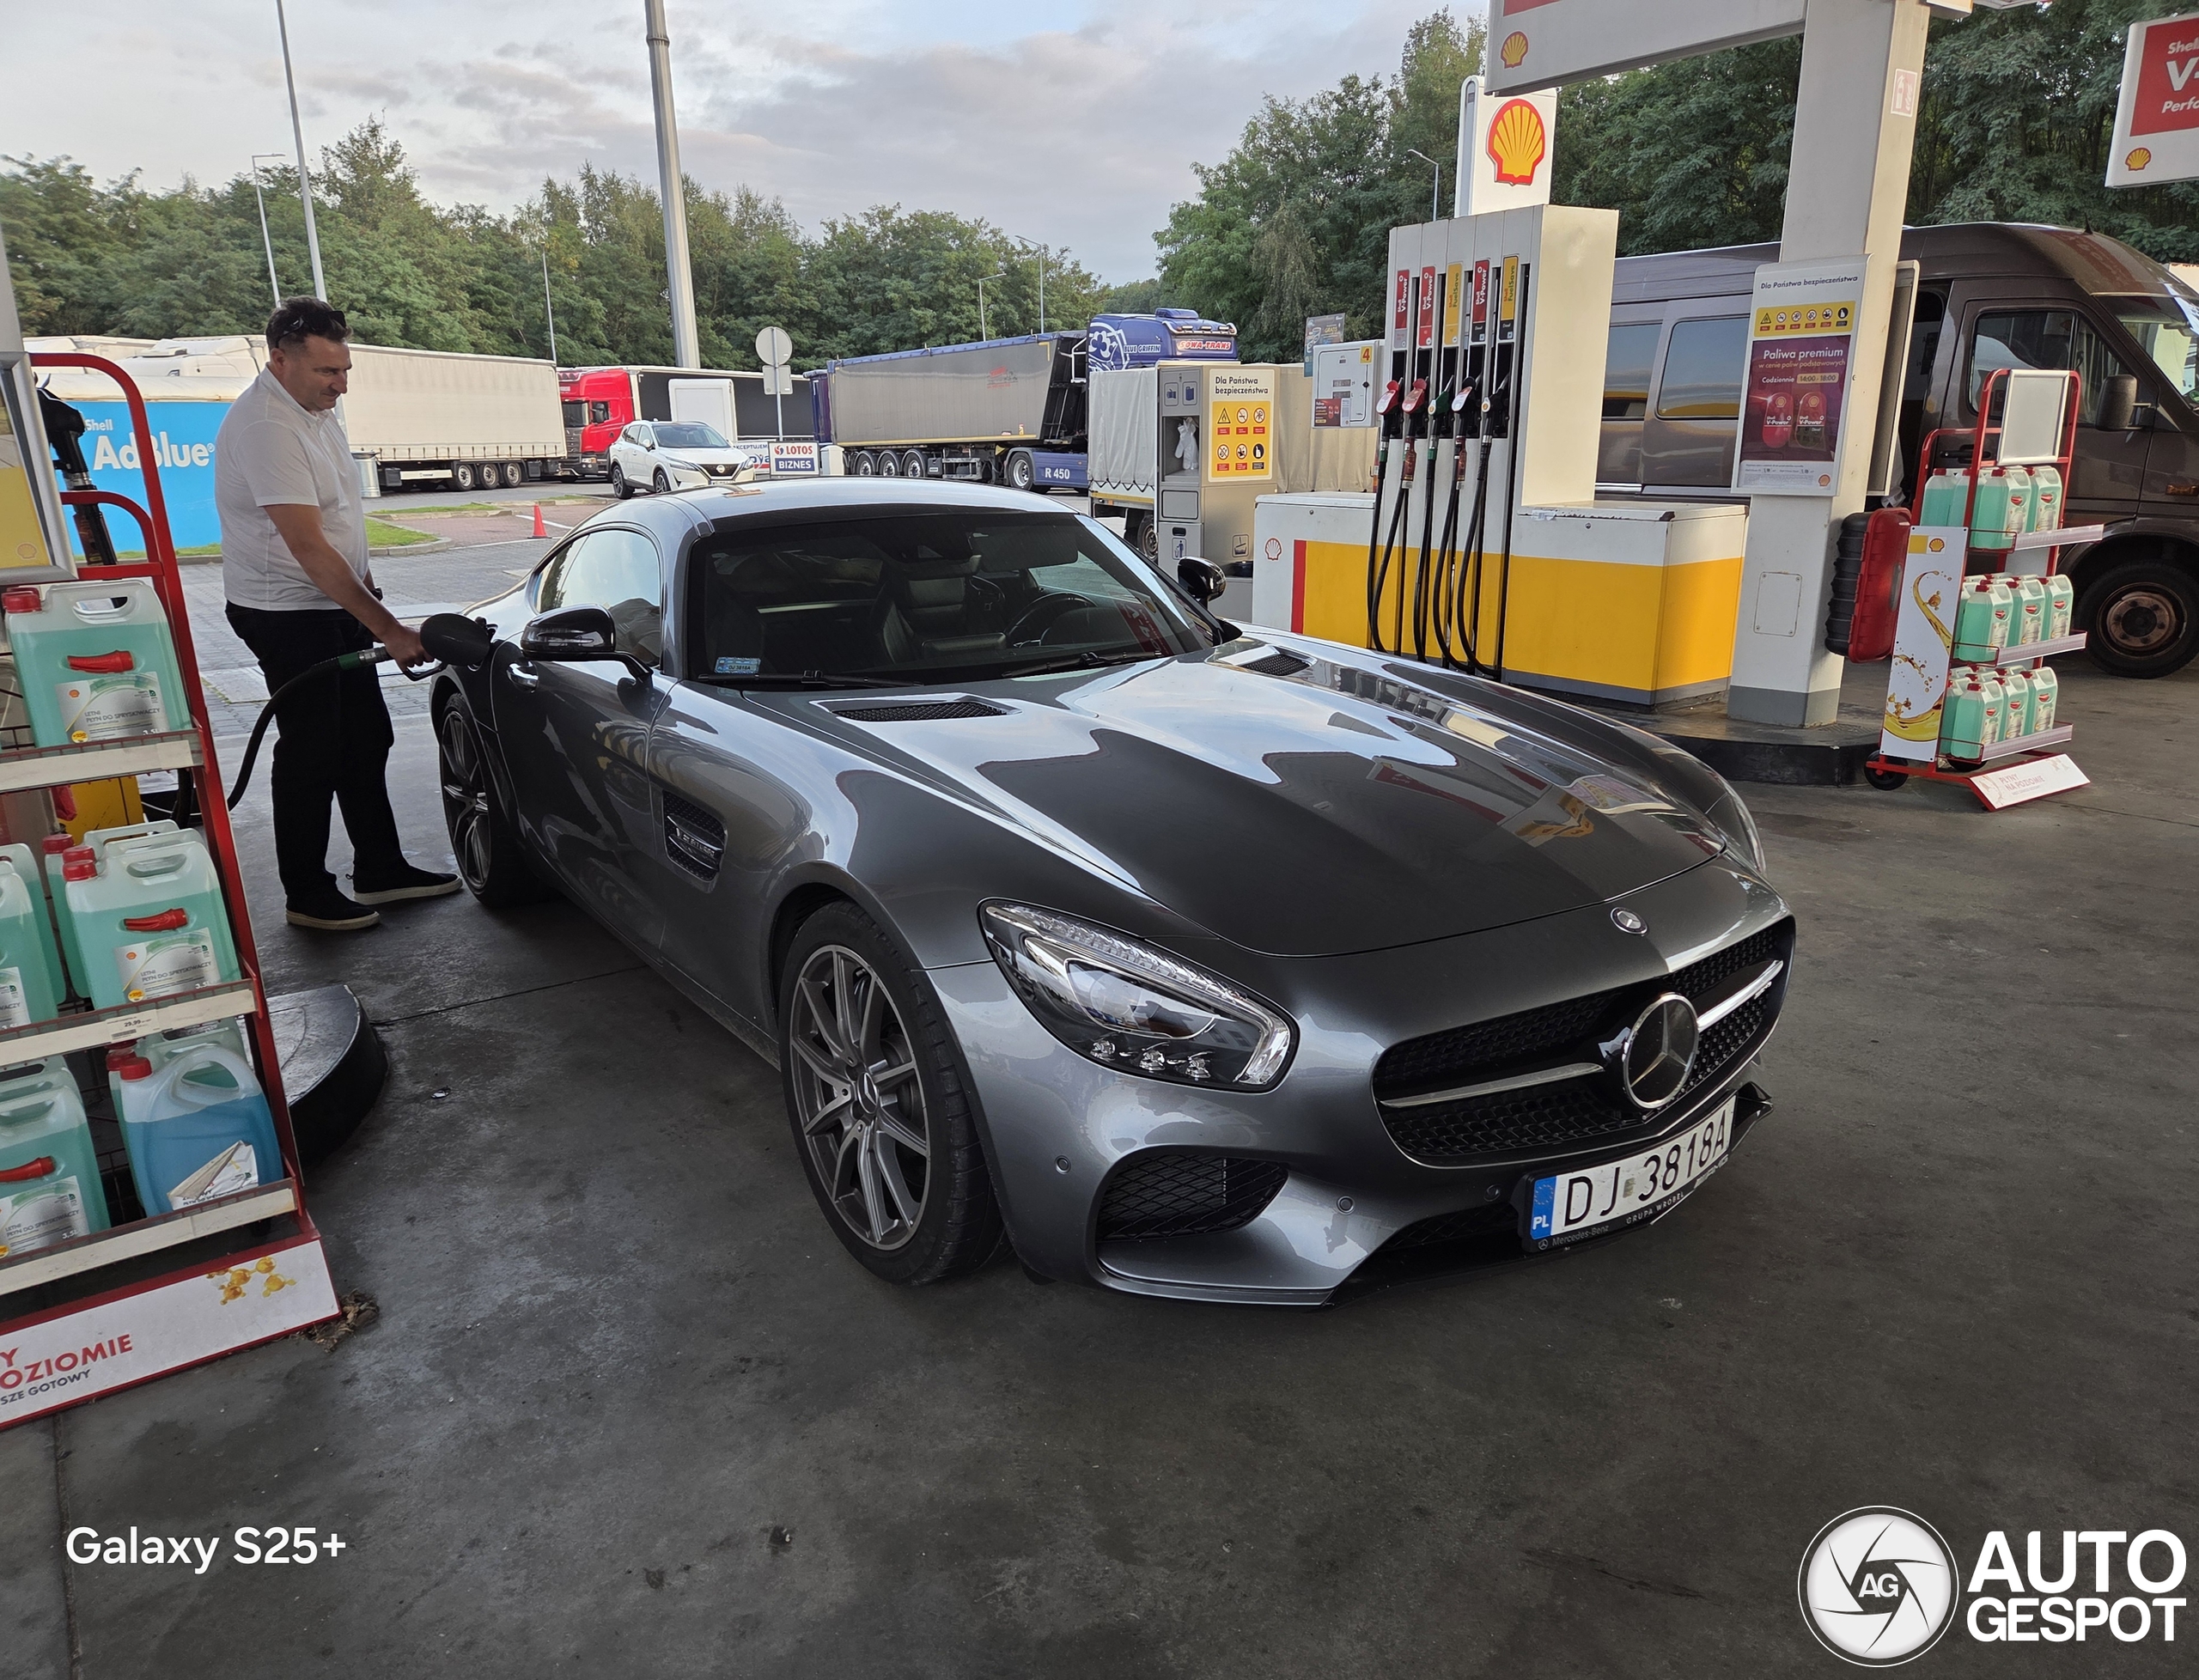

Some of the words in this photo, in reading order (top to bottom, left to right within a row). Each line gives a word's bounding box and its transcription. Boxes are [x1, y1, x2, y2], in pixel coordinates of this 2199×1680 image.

[1803, 276, 1859, 286] bezpieczeństwa
[1124, 344, 1137, 353] BLUE
[1138, 344, 1160, 353] GRIFFIN
[1362, 348, 1370, 361] 4
[1763, 348, 1796, 359] Paliwa
[1798, 347, 1843, 361] premium
[1800, 359, 1846, 368] podstawowych
[1215, 386, 1269, 396] bezpieczeństwa
[86, 419, 113, 431] Shell
[786, 446, 813, 454] LOTOS
[778, 460, 811, 469] BIZNES
[1045, 468, 1051, 478] R
[1053, 469, 1070, 479] 450
[1564, 1166, 1621, 1227] DJ
[1638, 1110, 1726, 1202] 3818A
[1532, 1215, 1549, 1230] PL
[1626, 1208, 1654, 1225] GRUPA
[1552, 1225, 1609, 1246] Mercedes-Benz
[27, 1369, 90, 1396] GOTOWY
